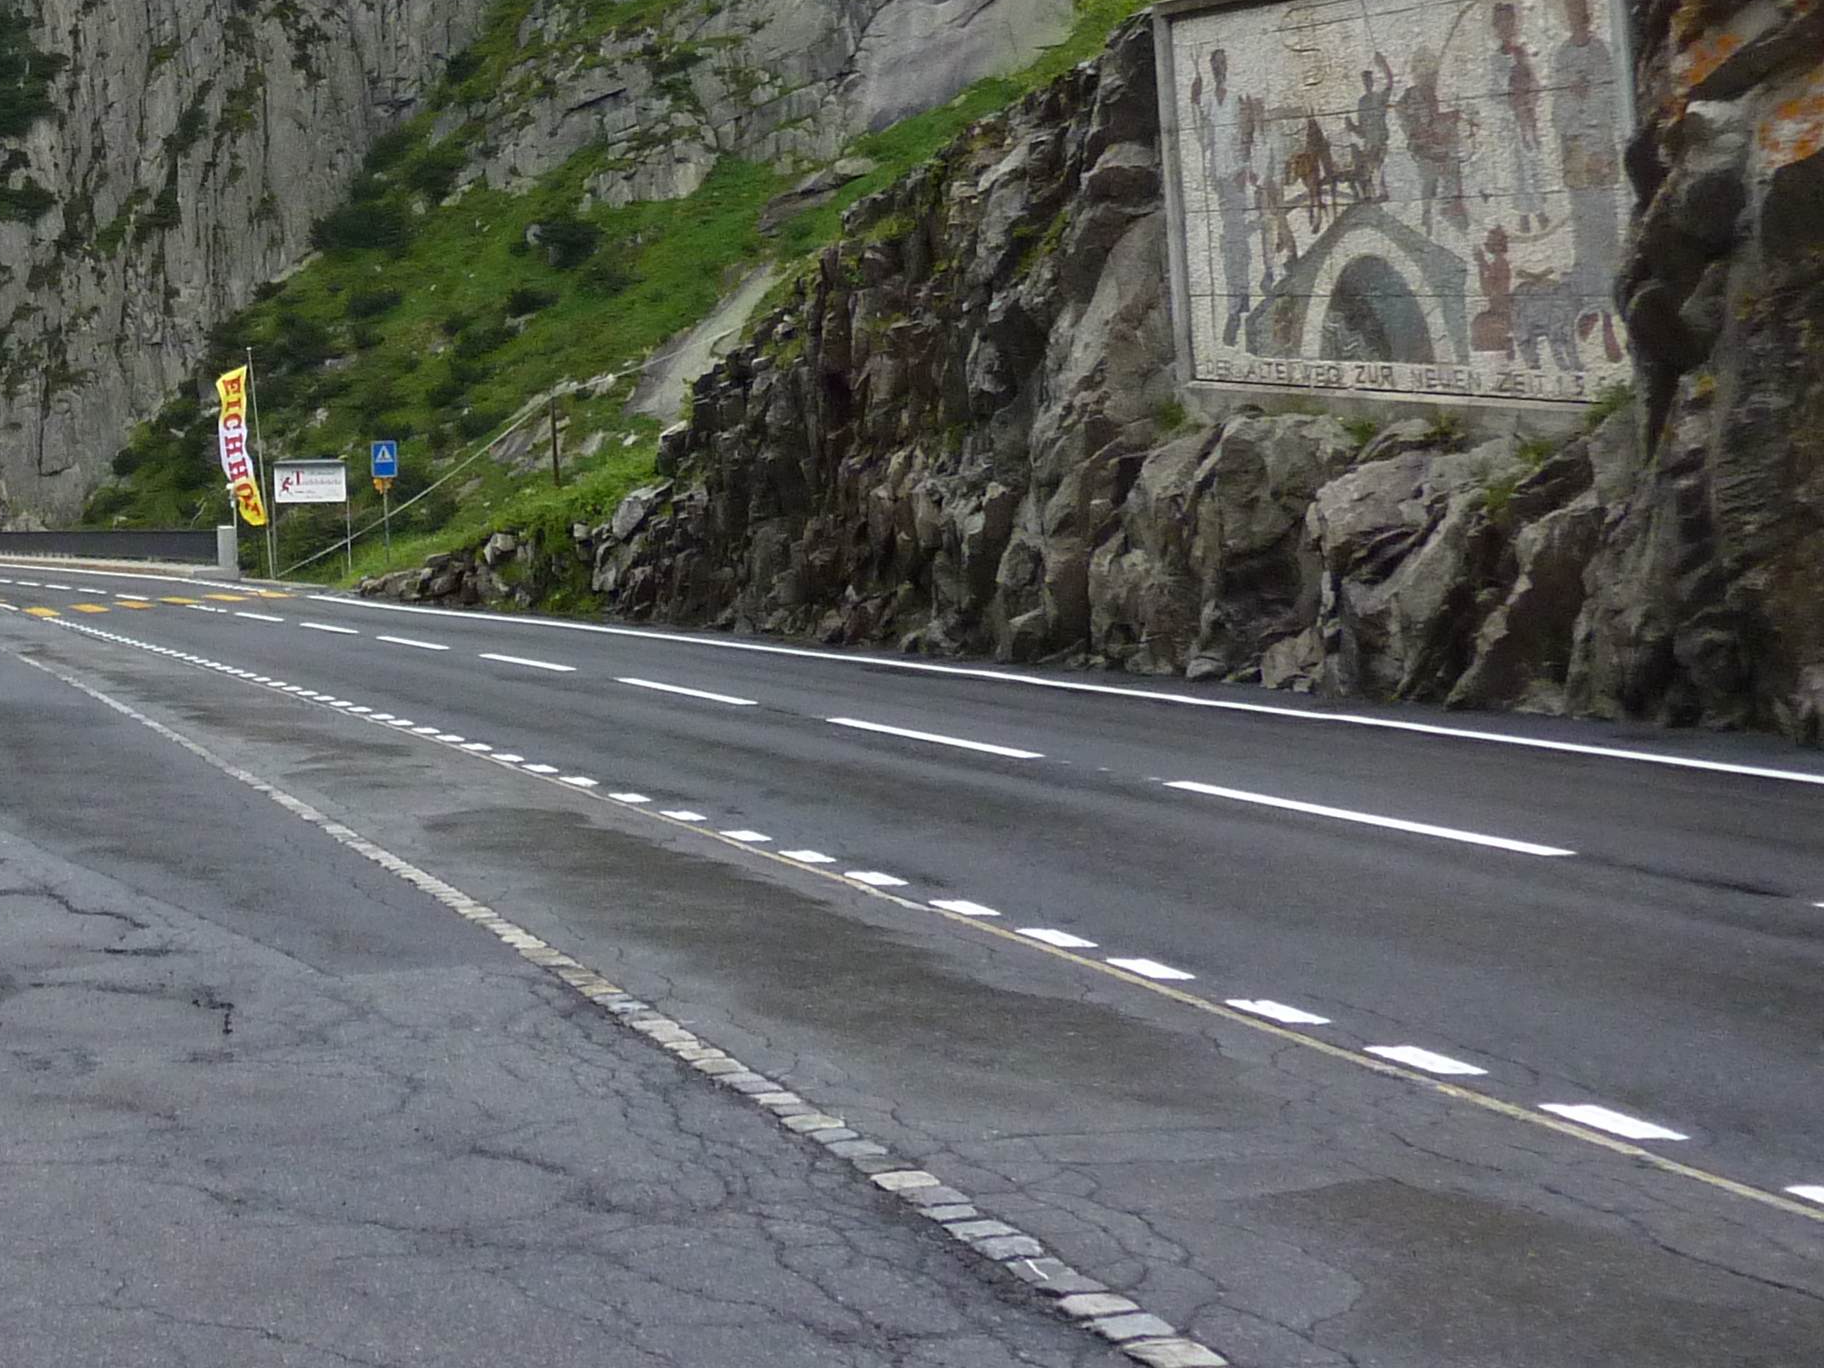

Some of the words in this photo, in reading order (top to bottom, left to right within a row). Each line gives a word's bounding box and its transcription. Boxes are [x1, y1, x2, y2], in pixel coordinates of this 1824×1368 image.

[1205, 358, 1232, 379] DER
[1245, 362, 1288, 381] ALTE
[1354, 366, 1396, 387] ZUR
[1493, 372, 1548, 395] ZEIT
